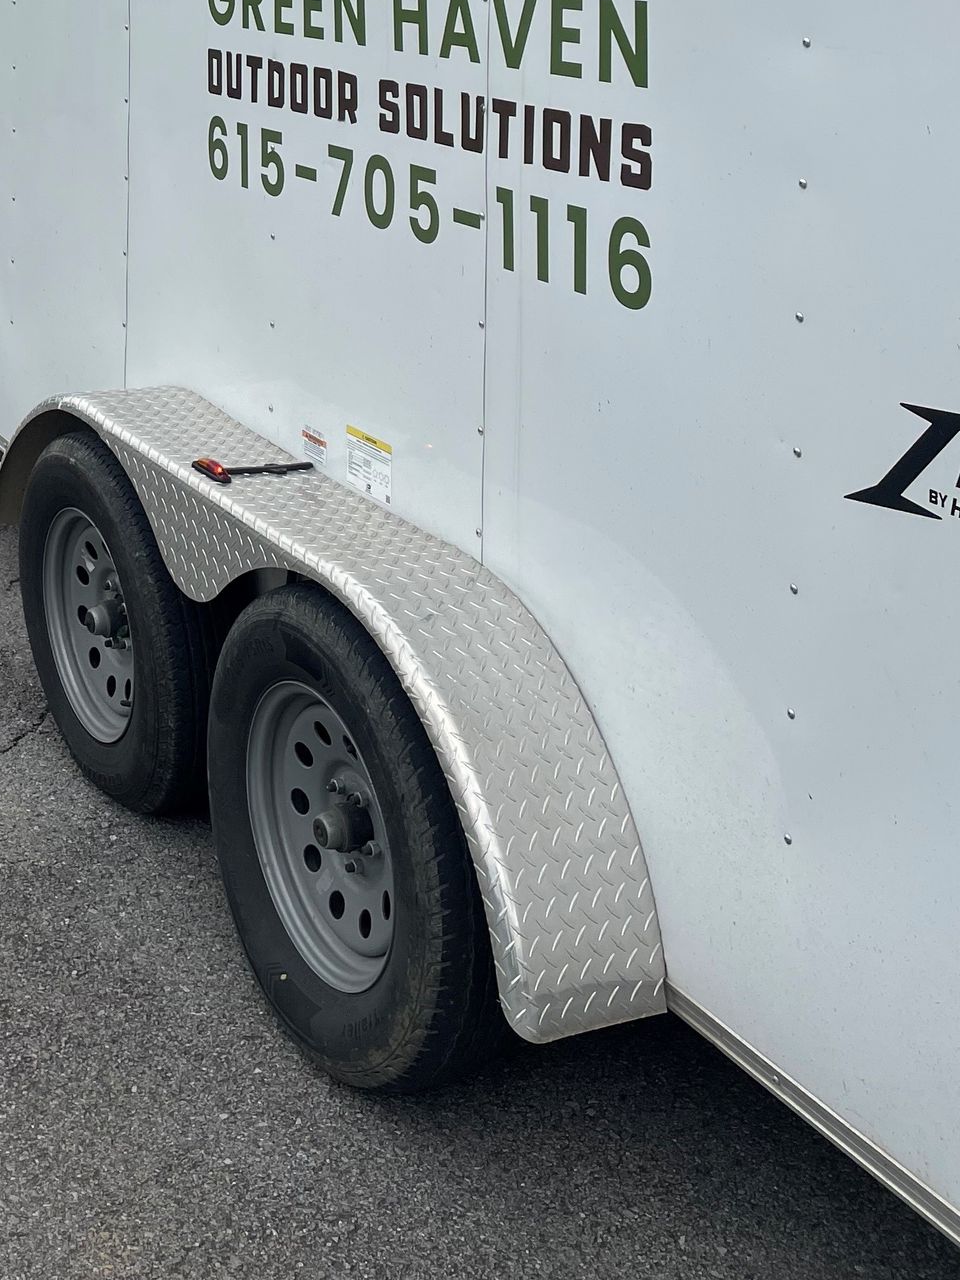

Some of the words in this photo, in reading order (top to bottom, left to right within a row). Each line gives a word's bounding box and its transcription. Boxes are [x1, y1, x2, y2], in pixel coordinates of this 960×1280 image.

[207, 48, 358, 124] OUTDOOR
[378, 78, 653, 191] SOLUTIONS
[207, 115, 653, 311] 615-705-1116
[928, 488, 948, 508] BY
